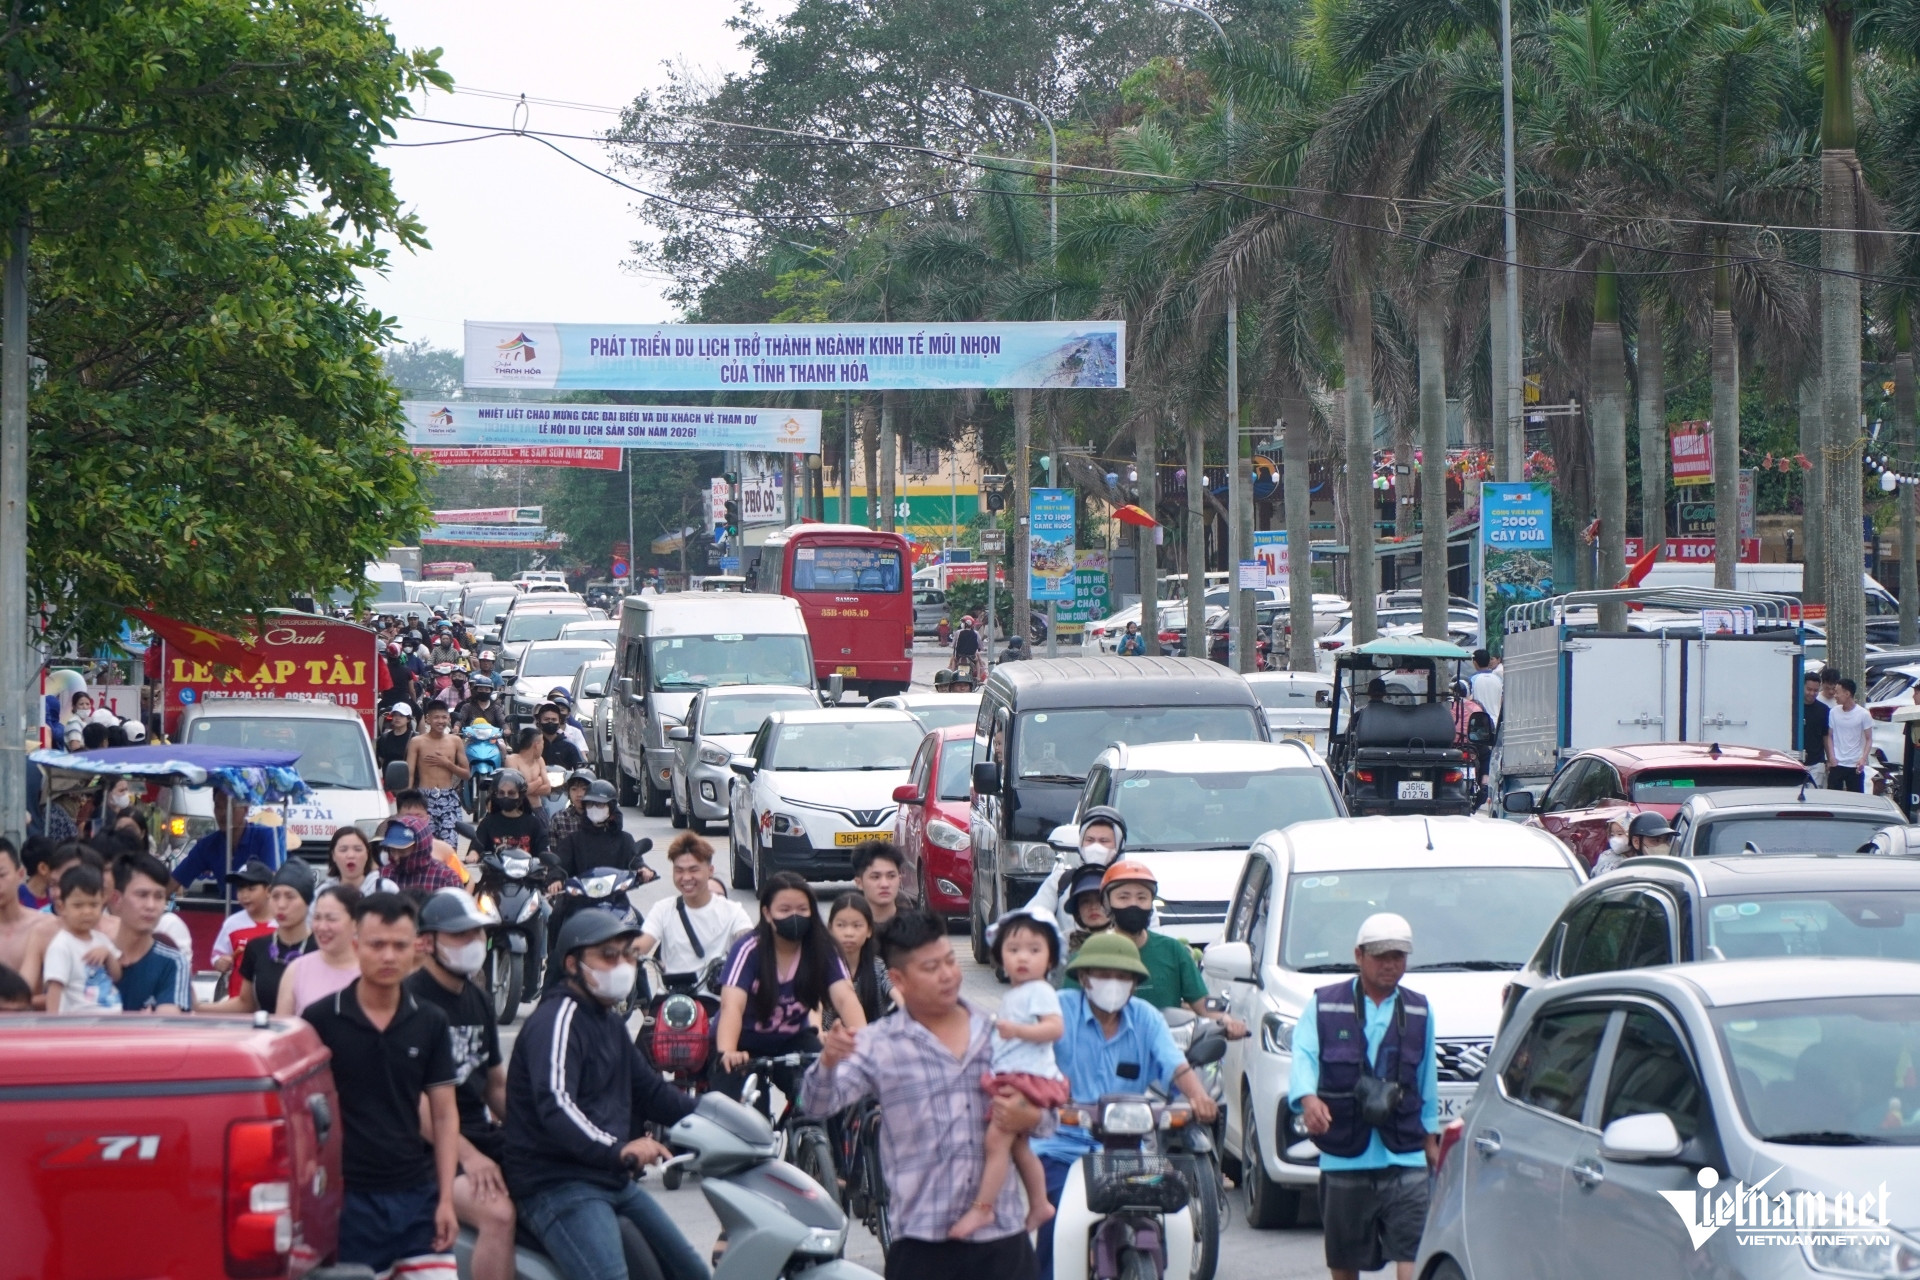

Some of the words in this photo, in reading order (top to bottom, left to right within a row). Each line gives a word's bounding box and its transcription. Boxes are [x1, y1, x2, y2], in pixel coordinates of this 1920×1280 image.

[590, 334, 626, 356] PHÁT
[630, 330, 671, 356] TRIỂN
[675, 338, 694, 357] DU
[699, 338, 730, 361] LỊCH
[734, 331, 761, 356] TRỞ
[764, 333, 811, 356] THÀNH
[815, 333, 865, 356] NGÀNH
[869, 336, 903, 355] KINH
[908, 330, 925, 355] TẾ
[929, 332, 956, 355] MŨI
[960, 336, 1001, 358] NHỌN
[720, 359, 749, 383] CỦA
[752, 358, 785, 383] TỈNH
[789, 363, 836, 383] THANH
[840, 360, 869, 382] HÓA
[478, 406, 504, 420] NHIỆT
[506, 407, 524, 421] LIỆT
[656, 412, 669, 423] DU
[671, 411, 701, 423] KHÁCH
[703, 411, 714, 424] VỀ
[717, 414, 742, 425] THAM
[744, 414, 758, 426] DỰ
[550, 422, 566, 436] HỘI
[568, 424, 581, 435] DU
[583, 425, 603, 436] LỊCH
[627, 425, 647, 437] SƠN
[670, 427, 697, 438] 2026!
[583, 449, 604, 460] 2026!
[1502, 516, 1537, 527] 2000
[1490, 527, 1517, 541] CÂY
[1519, 525, 1545, 541] DỪA
[304, 653, 367, 686] TÀI
[1405, 783, 1426, 791] 36HC
[302, 806, 333, 820] TÀI
[311, 824, 325, 836] 155
